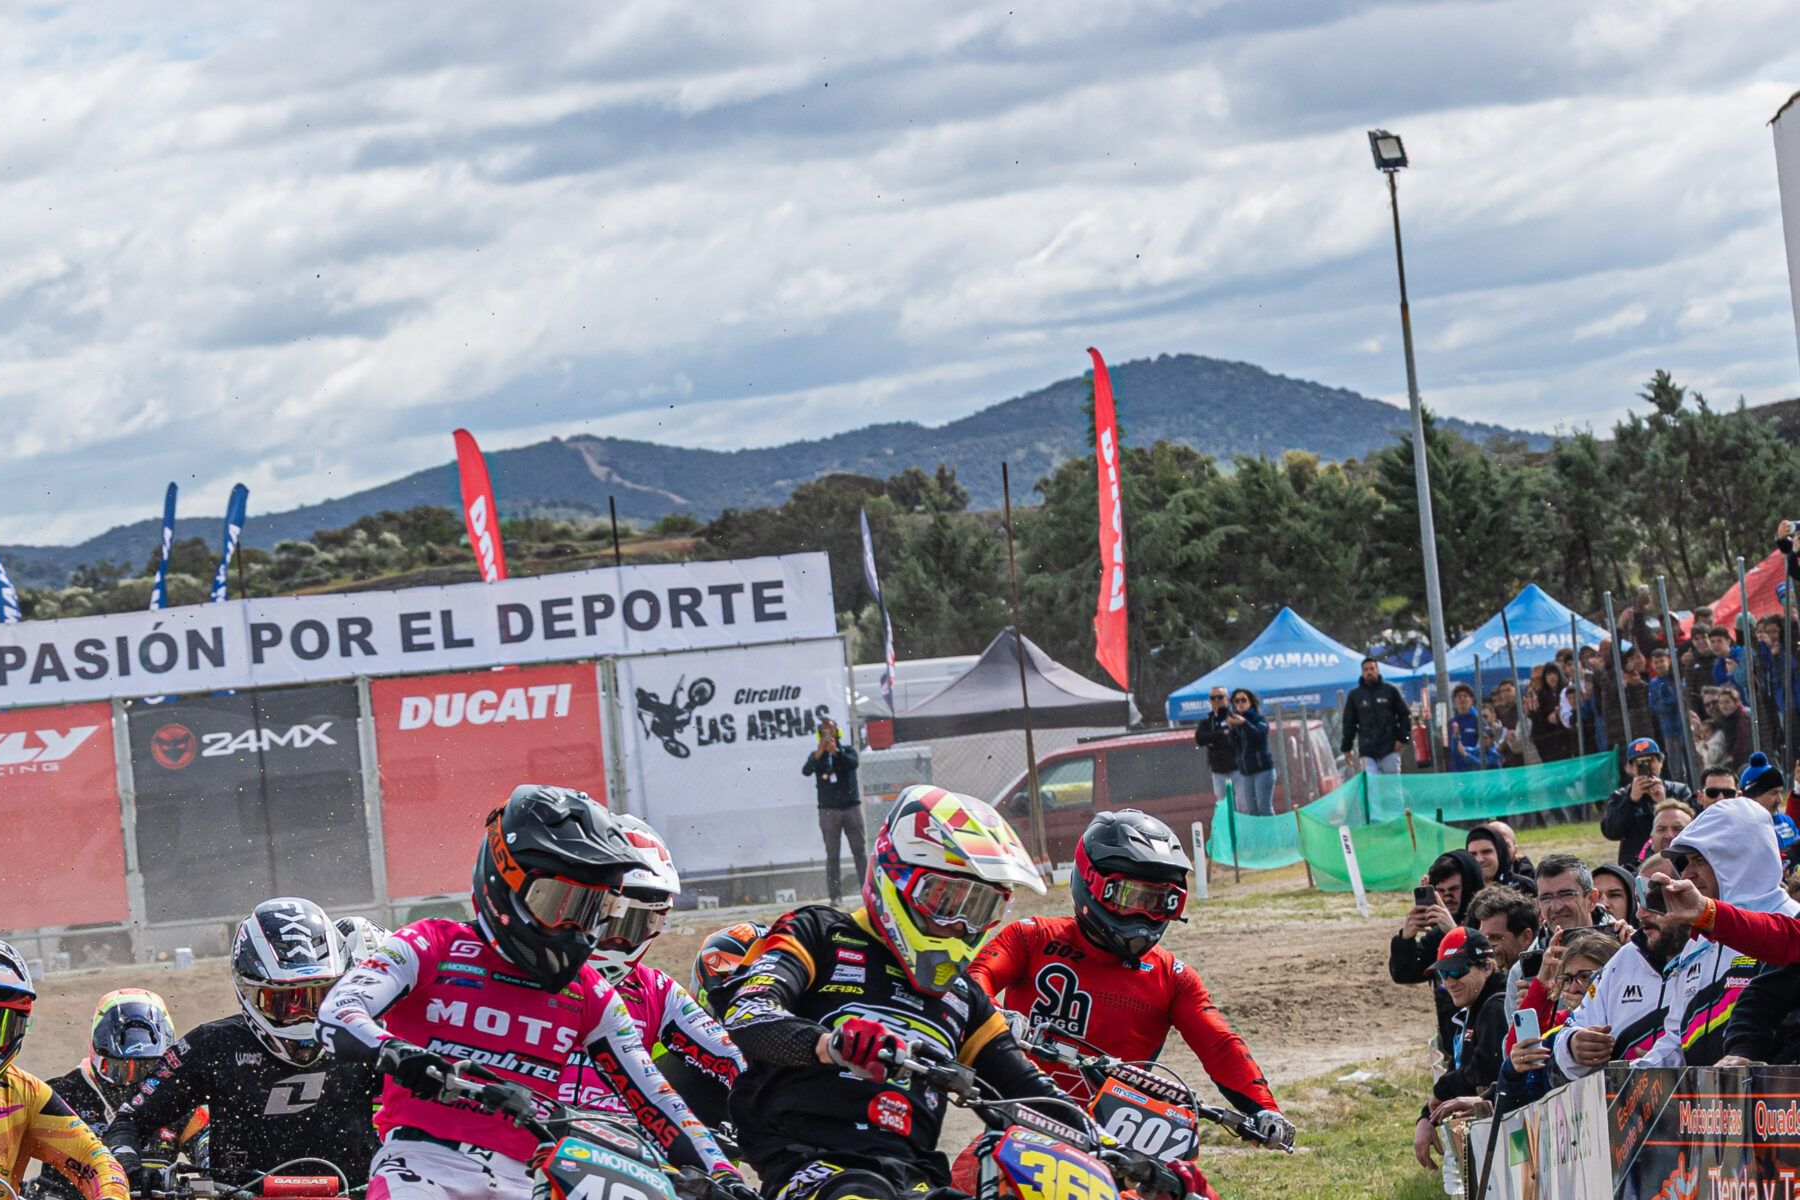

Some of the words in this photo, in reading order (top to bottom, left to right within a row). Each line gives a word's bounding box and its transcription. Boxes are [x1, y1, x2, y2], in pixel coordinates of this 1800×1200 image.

[250, 616, 378, 664] POR
[399, 609, 474, 653] EL
[497, 580, 788, 645] DEPORTE
[1262, 652, 1340, 667] YAMAHA
[399, 684, 573, 731] DUCATI
[734, 684, 801, 705] Circuito
[202, 722, 337, 757] 24MX
[696, 712, 738, 746] LAS
[747, 704, 831, 741] ARENAS
[1043, 940, 1084, 962] 602
[427, 999, 578, 1052] MOTS
[1016, 1109, 1084, 1145] RENTHAL
[1103, 1106, 1197, 1165] 602
[1679, 1101, 1743, 1135] Motocicletas
[273, 1179, 328, 1187] GASGAS
[591, 1149, 670, 1196] MOTOREX
